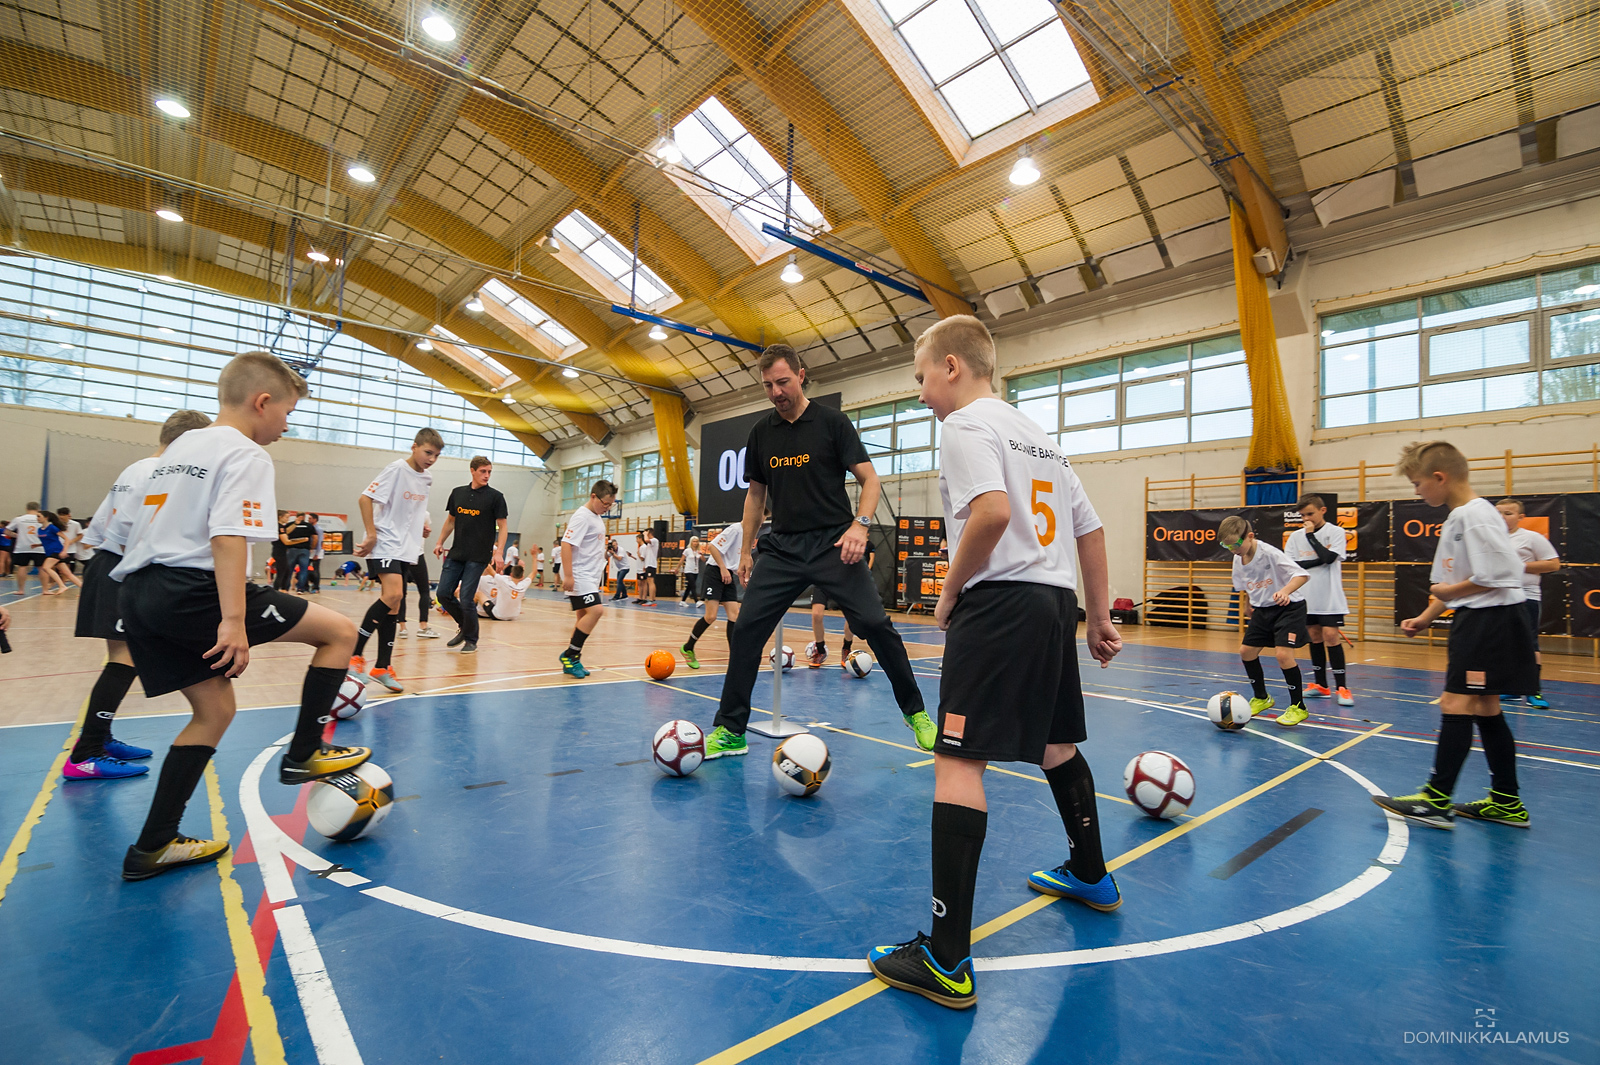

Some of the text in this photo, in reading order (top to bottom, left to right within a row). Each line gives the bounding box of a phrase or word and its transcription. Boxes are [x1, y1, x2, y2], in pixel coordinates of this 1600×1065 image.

[769, 453, 810, 469] Orange
[143, 493, 169, 525] 7
[457, 506, 481, 517] Orange
[1030, 478, 1057, 547] 5
[27, 525, 37, 535] 2
[1153, 526, 1217, 545] Orange
[1403, 519, 1444, 538] Ora
[380, 559, 393, 569] 17
[706, 587, 714, 596] 2
[582, 593, 596, 605] 20
